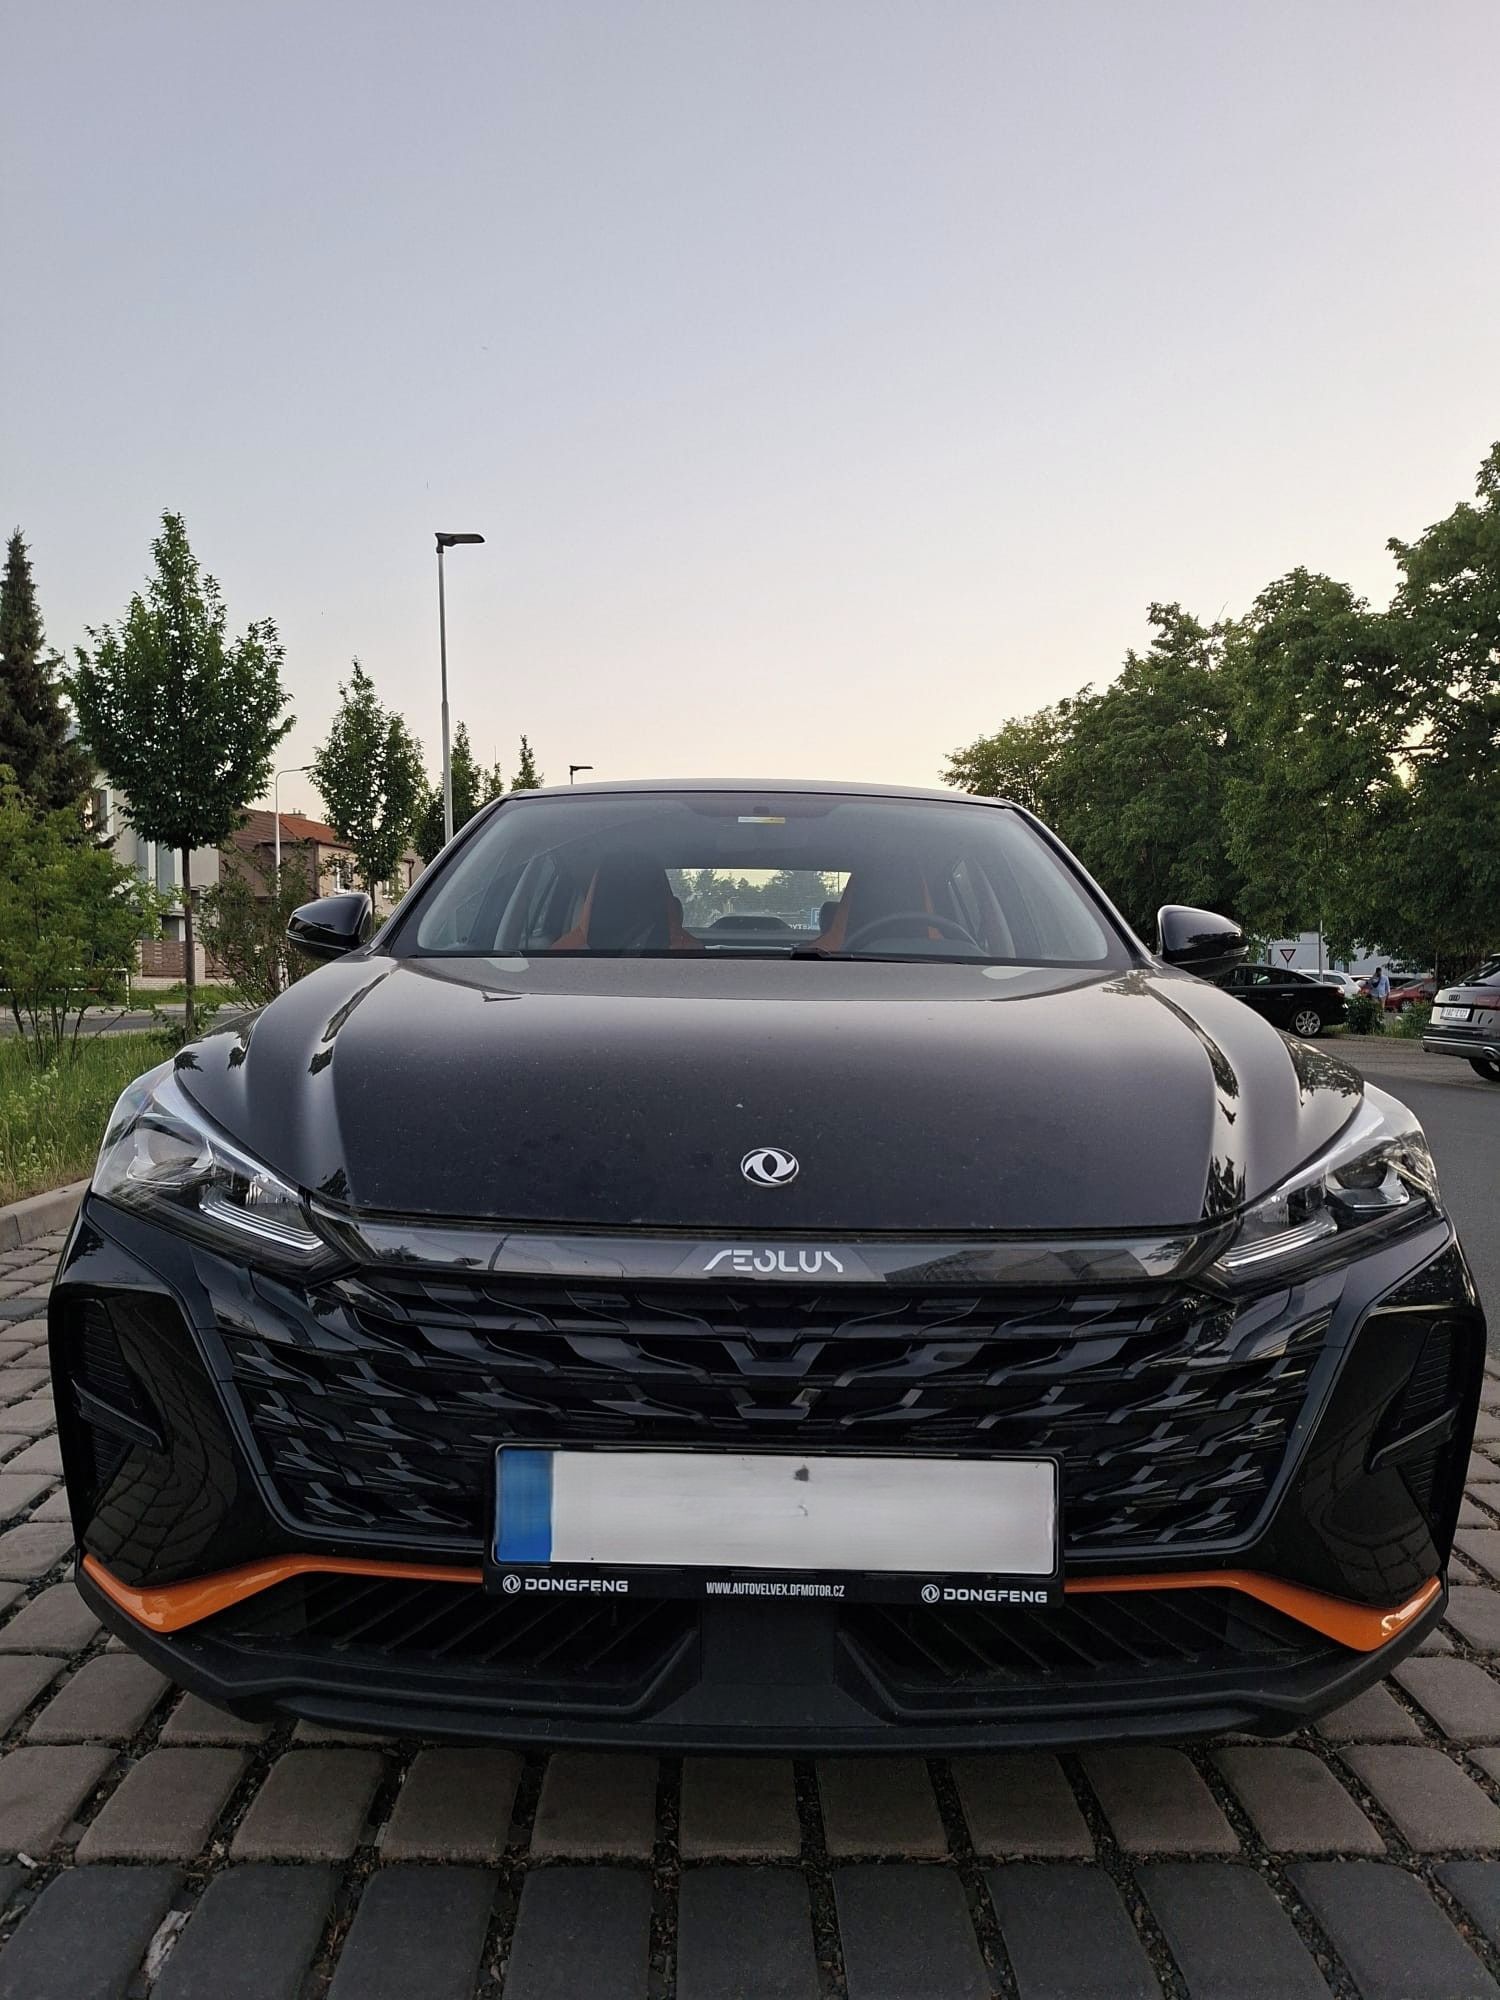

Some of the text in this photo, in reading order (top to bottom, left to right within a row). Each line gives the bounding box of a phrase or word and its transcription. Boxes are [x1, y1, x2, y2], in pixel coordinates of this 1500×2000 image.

[524, 1578, 629, 1593] DONGFENG
[706, 1581, 845, 1597] WWW.AUTOVELVEX.DFMOTOR.CZ
[943, 1588, 1048, 1603] DONGFENG
